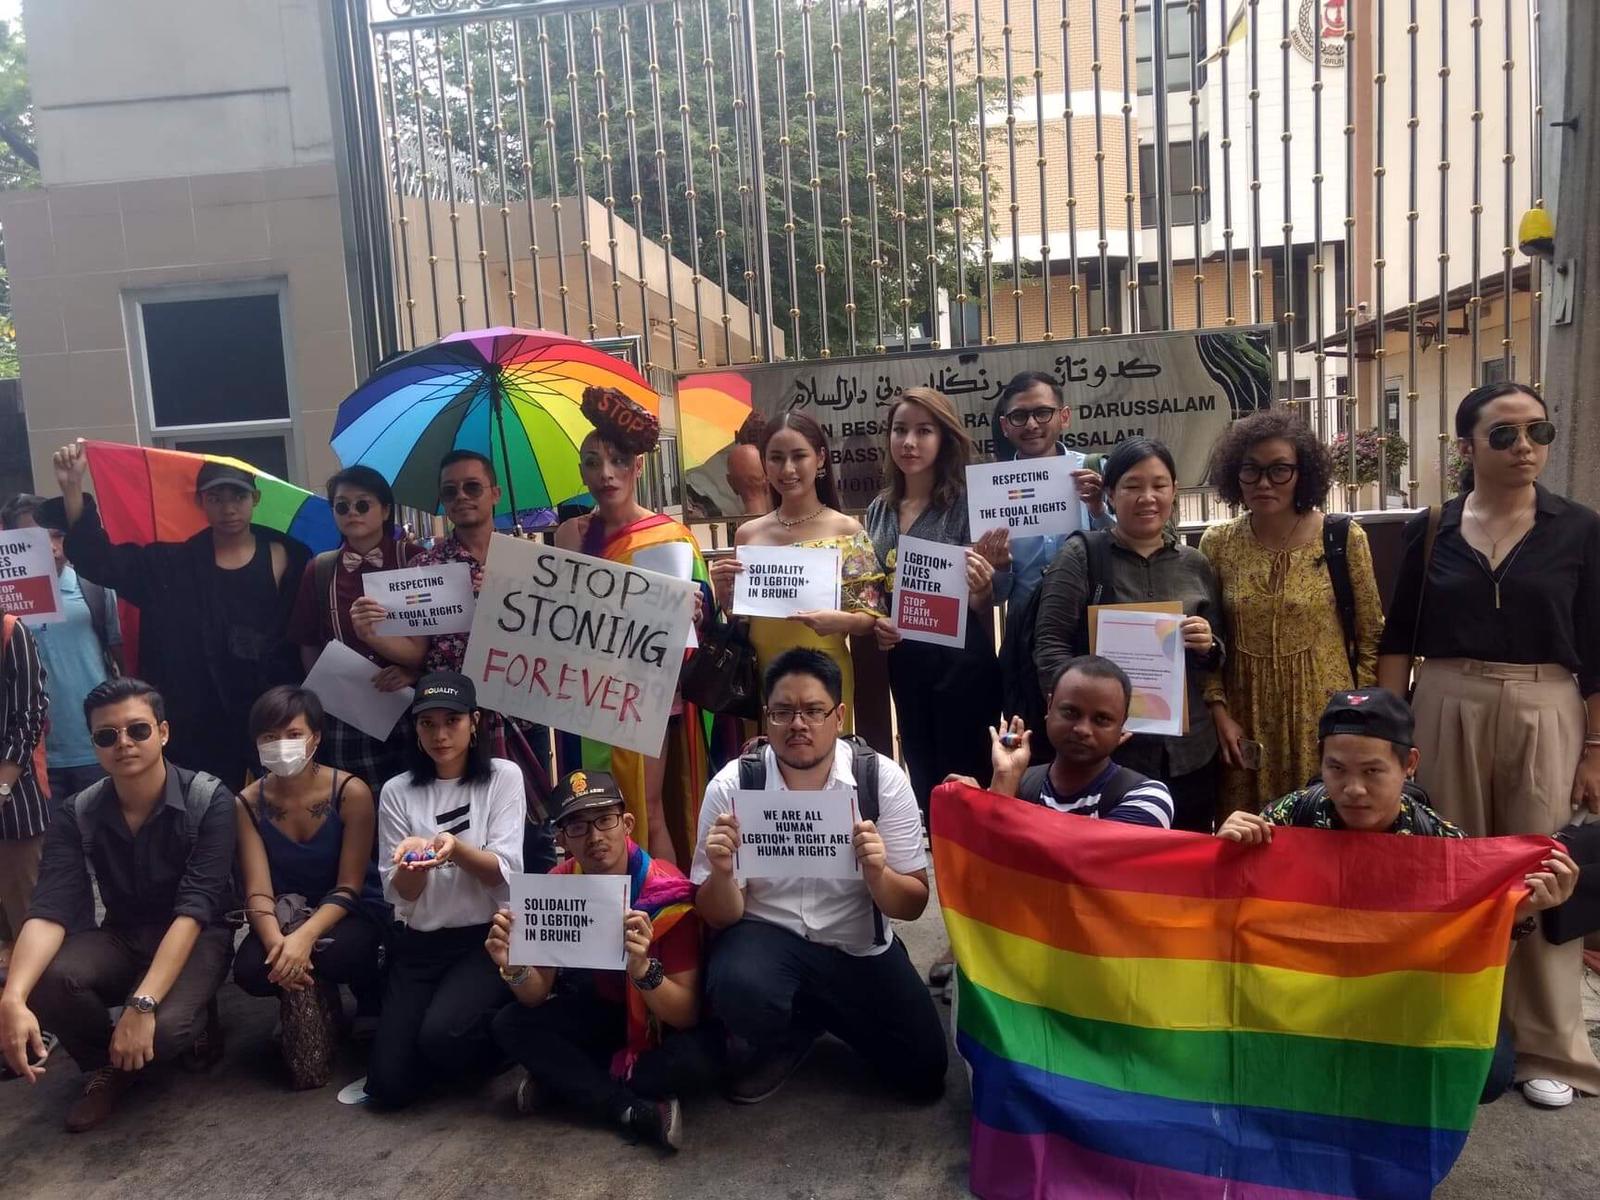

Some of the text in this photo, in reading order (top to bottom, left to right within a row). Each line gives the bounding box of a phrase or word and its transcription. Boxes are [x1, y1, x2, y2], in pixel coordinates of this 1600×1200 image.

[598, 393, 649, 433] STOP
[1079, 395, 1216, 420] DARUSSALAM
[992, 470, 1049, 486] RESPECTING
[980, 501, 1067, 519] THE EQUAL RIGHTS
[1008, 515, 1040, 527] OF ALL
[0, 542, 32, 555] TIQN+
[904, 551, 953, 570] LGBTIQN+
[749, 564, 804, 575] SOLIDALITY
[903, 564, 930, 580] LIVES
[389, 576, 444, 592] RESPECTING
[532, 554, 650, 611] STOP
[749, 576, 810, 588] TO LGBTIQN+
[901, 576, 942, 593] MATTER
[748, 588, 798, 599] IN BRUNEI
[903, 595, 927, 607] STOP
[399, 608, 428, 619] EQUAL
[430, 604, 463, 617] RIGHTS
[903, 605, 930, 617] DEATH
[409, 618, 439, 627] OF ALL
[902, 615, 939, 628] PENALTY
[497, 591, 669, 668] STONING
[483, 647, 642, 723] FOREVER
[763, 810, 823, 821] WE ARE ALL
[775, 822, 813, 832] HUMAN
[742, 833, 851, 845] LGBTIQN+ RIGHT ARE
[757, 845, 837, 857] HUMAN RIGHTS
[524, 898, 587, 911] SOLIDALITY
[524, 913, 594, 928] TO LGBTIQN+
[525, 929, 581, 942] IN BRUNEI
